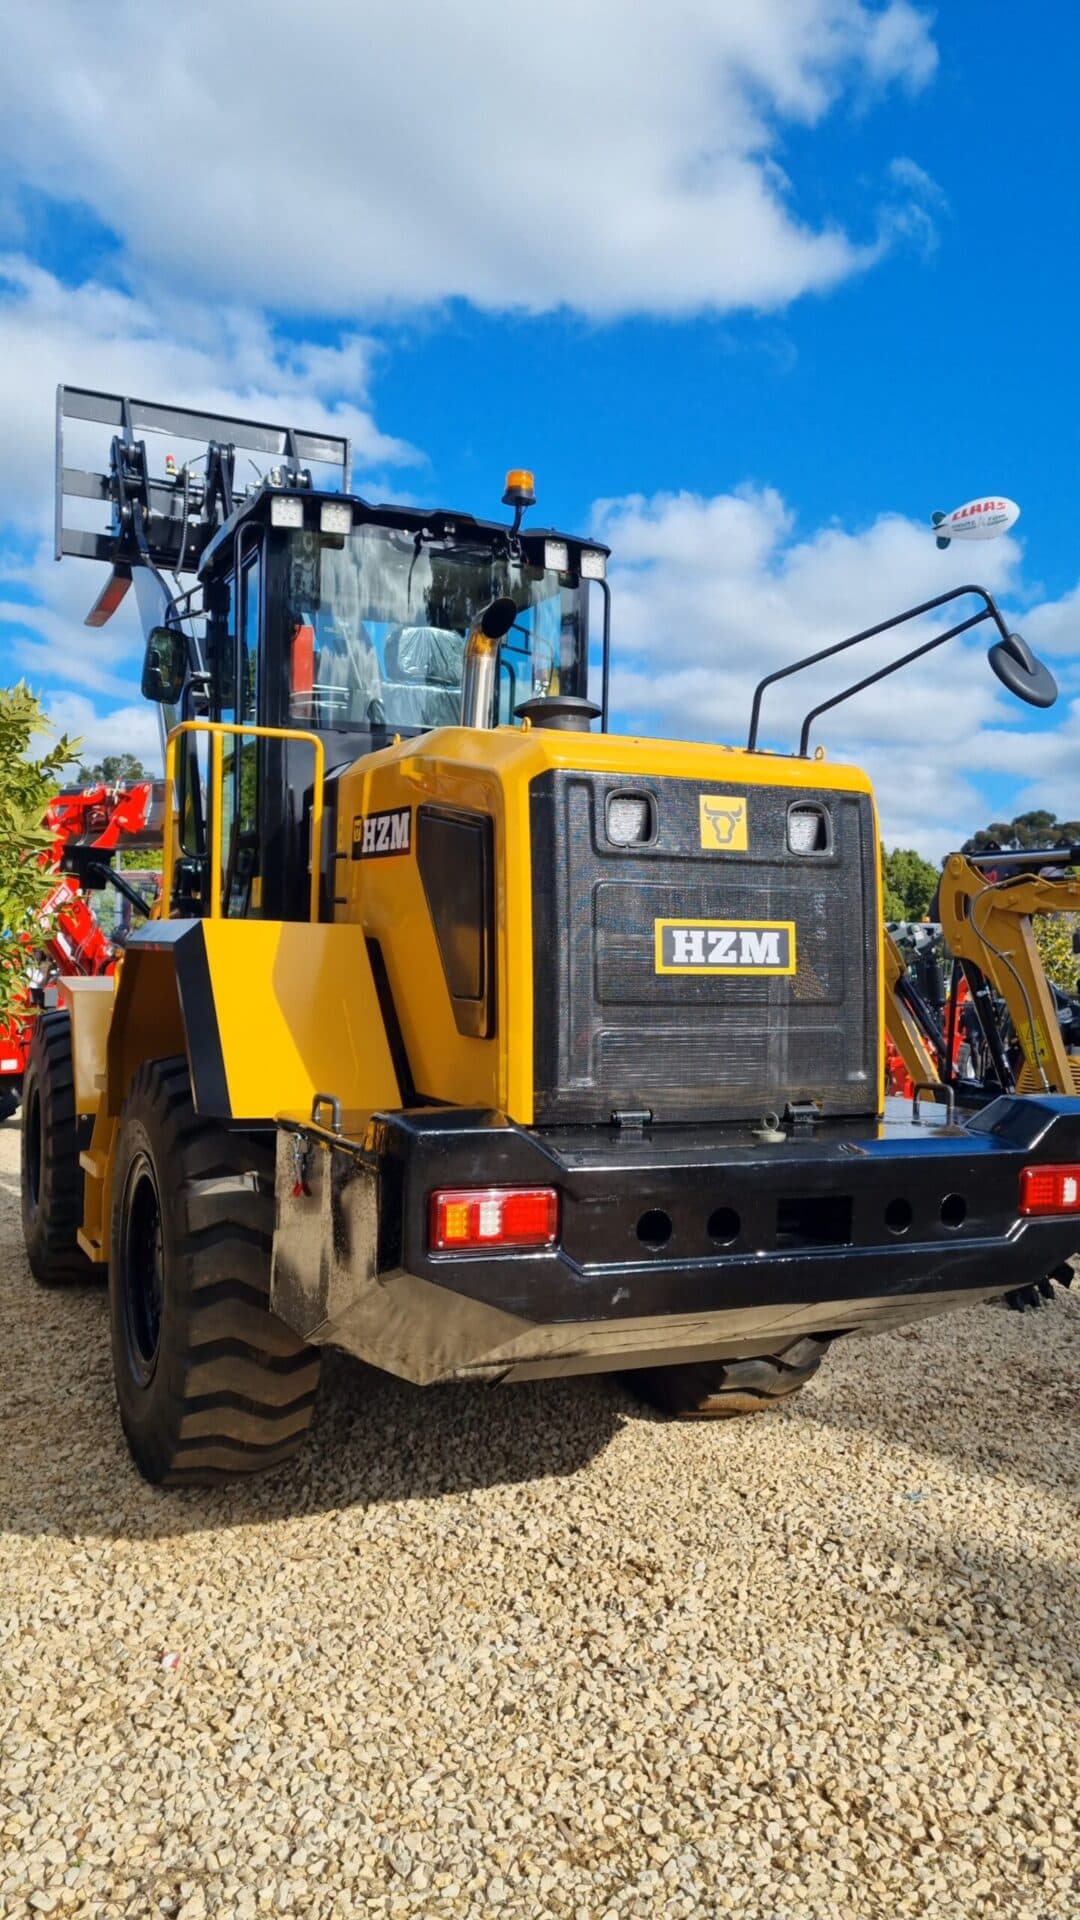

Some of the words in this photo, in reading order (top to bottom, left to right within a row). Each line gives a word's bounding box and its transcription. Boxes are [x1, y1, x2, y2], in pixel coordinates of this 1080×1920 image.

[952, 501, 1007, 521] CLAAS
[362, 812, 410, 853] HZM
[672, 930, 780, 964] HZM
